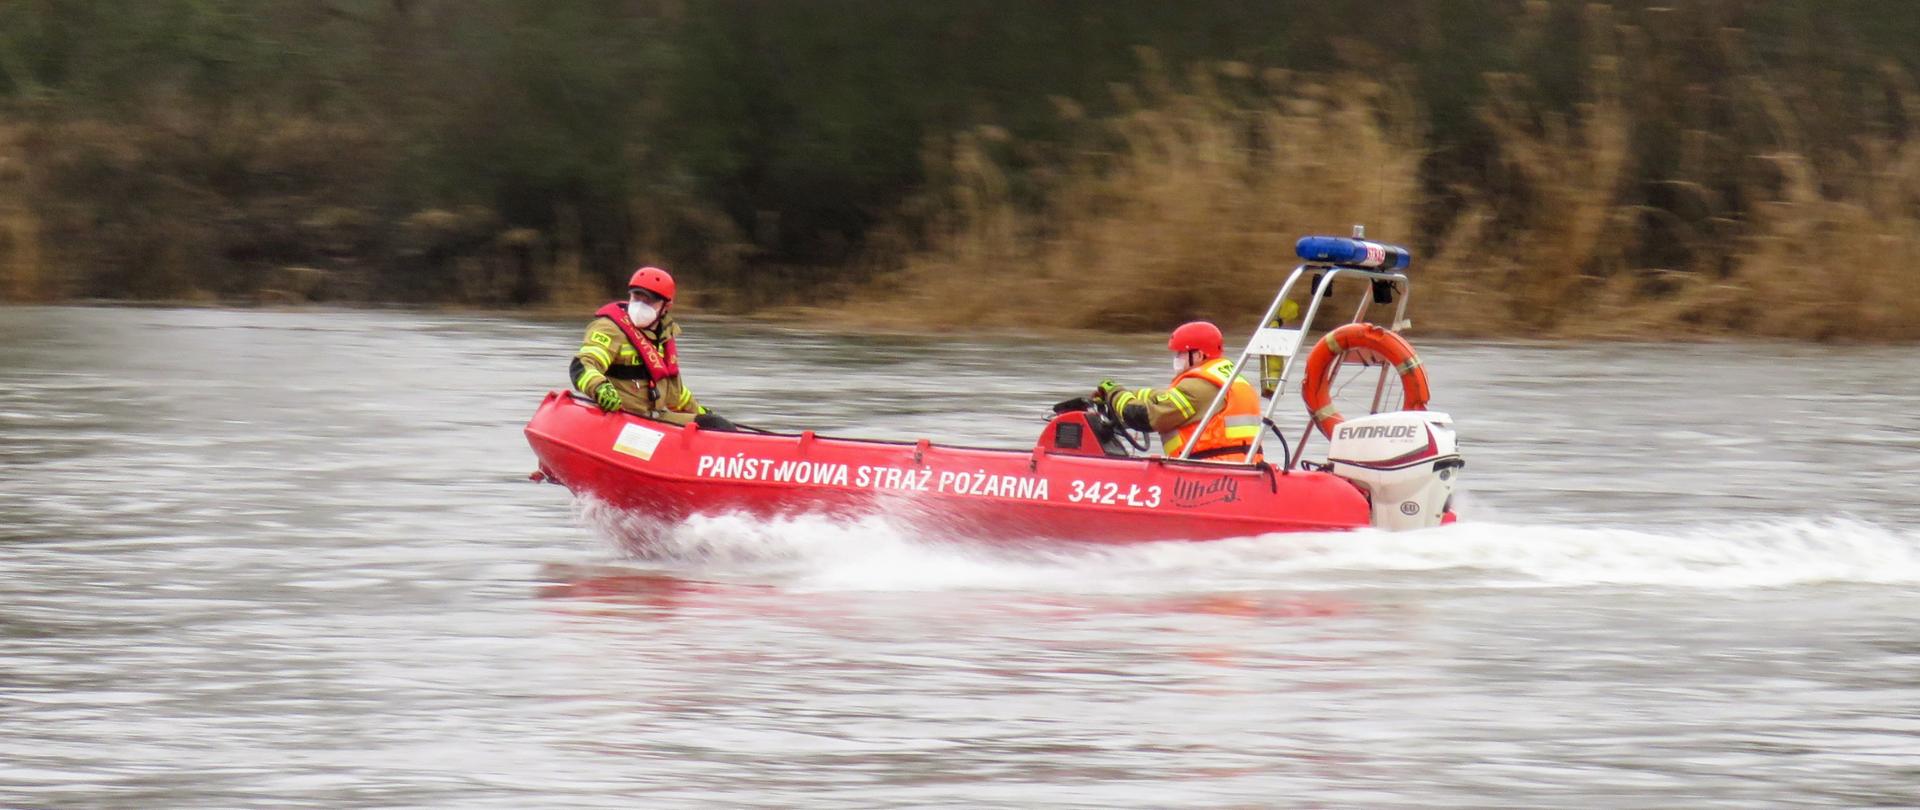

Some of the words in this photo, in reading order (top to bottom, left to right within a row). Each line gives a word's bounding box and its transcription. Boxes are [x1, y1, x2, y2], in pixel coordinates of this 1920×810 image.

[594, 333, 609, 343] PSP
[1339, 425, 1417, 440] EVINRUDE
[697, 453, 848, 486] PAŃSTWOWA
[856, 465, 933, 492] STRAŻ
[938, 470, 1049, 500] POŻARNA
[1068, 479, 1162, 508] 342-Ł3
